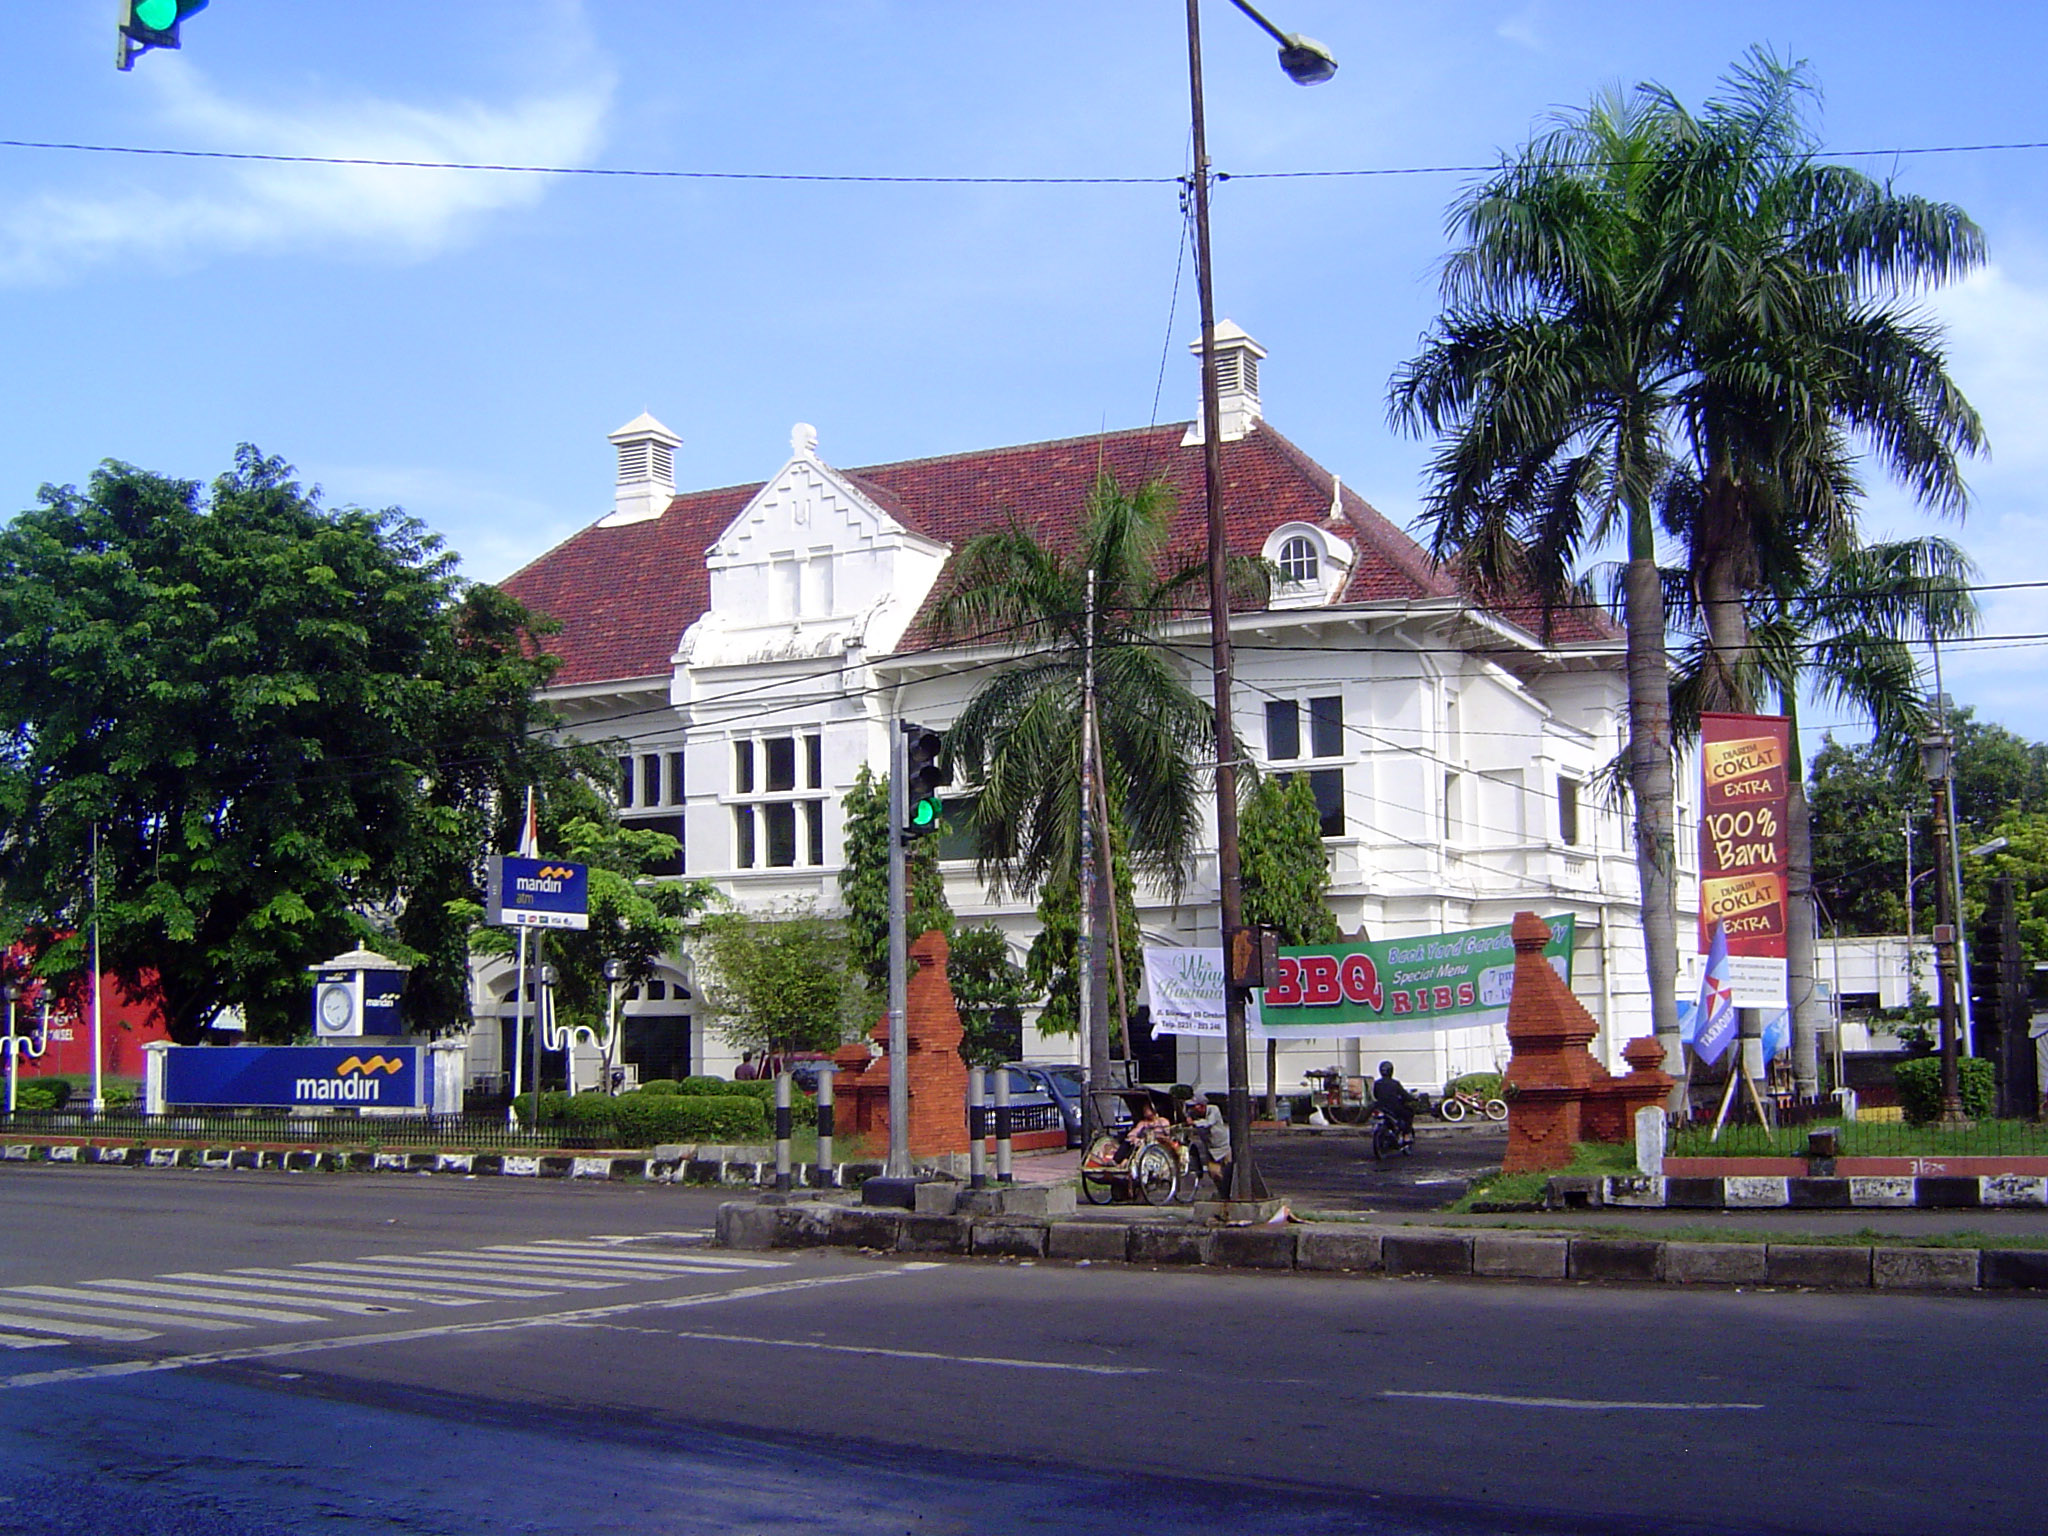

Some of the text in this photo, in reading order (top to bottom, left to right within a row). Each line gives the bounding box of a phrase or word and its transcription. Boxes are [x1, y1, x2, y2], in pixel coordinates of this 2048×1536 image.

[1713, 749, 1773, 778] COKLAT
[1724, 779, 1772, 797] EXTRA
[1716, 840, 1777, 870] Baru
[516, 876, 561, 893] mandiri
[516, 893, 534, 904] atm
[1711, 886, 1772, 915] COKLAT
[1722, 915, 1770, 934] EXTRA
[1388, 930, 1515, 965] Back Yard Garde
[1263, 953, 1383, 1012] BBQ
[1392, 964, 1469, 985] Special Menu
[1489, 970, 1496, 982] 7
[1391, 982, 1476, 1015] RIBS
[296, 1072, 379, 1100] mandiri
